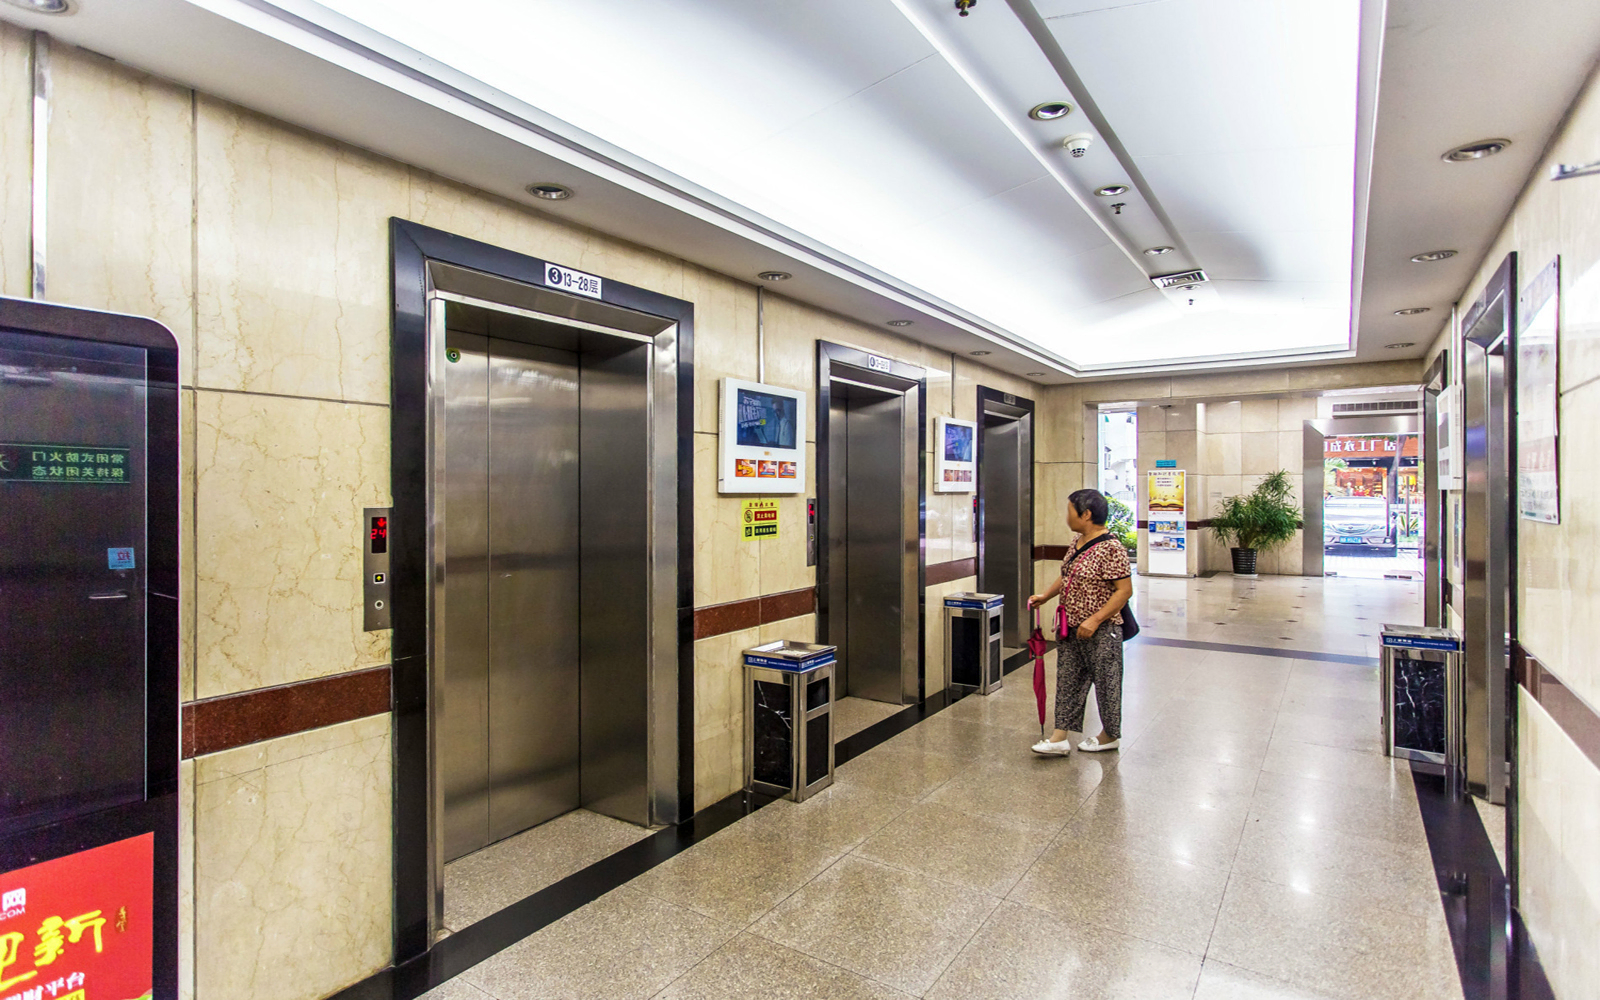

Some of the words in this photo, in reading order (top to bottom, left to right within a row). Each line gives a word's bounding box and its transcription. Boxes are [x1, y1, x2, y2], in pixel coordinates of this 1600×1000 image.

[563, 272, 599, 294] 13-28层
[1324, 440, 1397, 452] 成衣工厂店
[370, 528, 387, 539] 24
